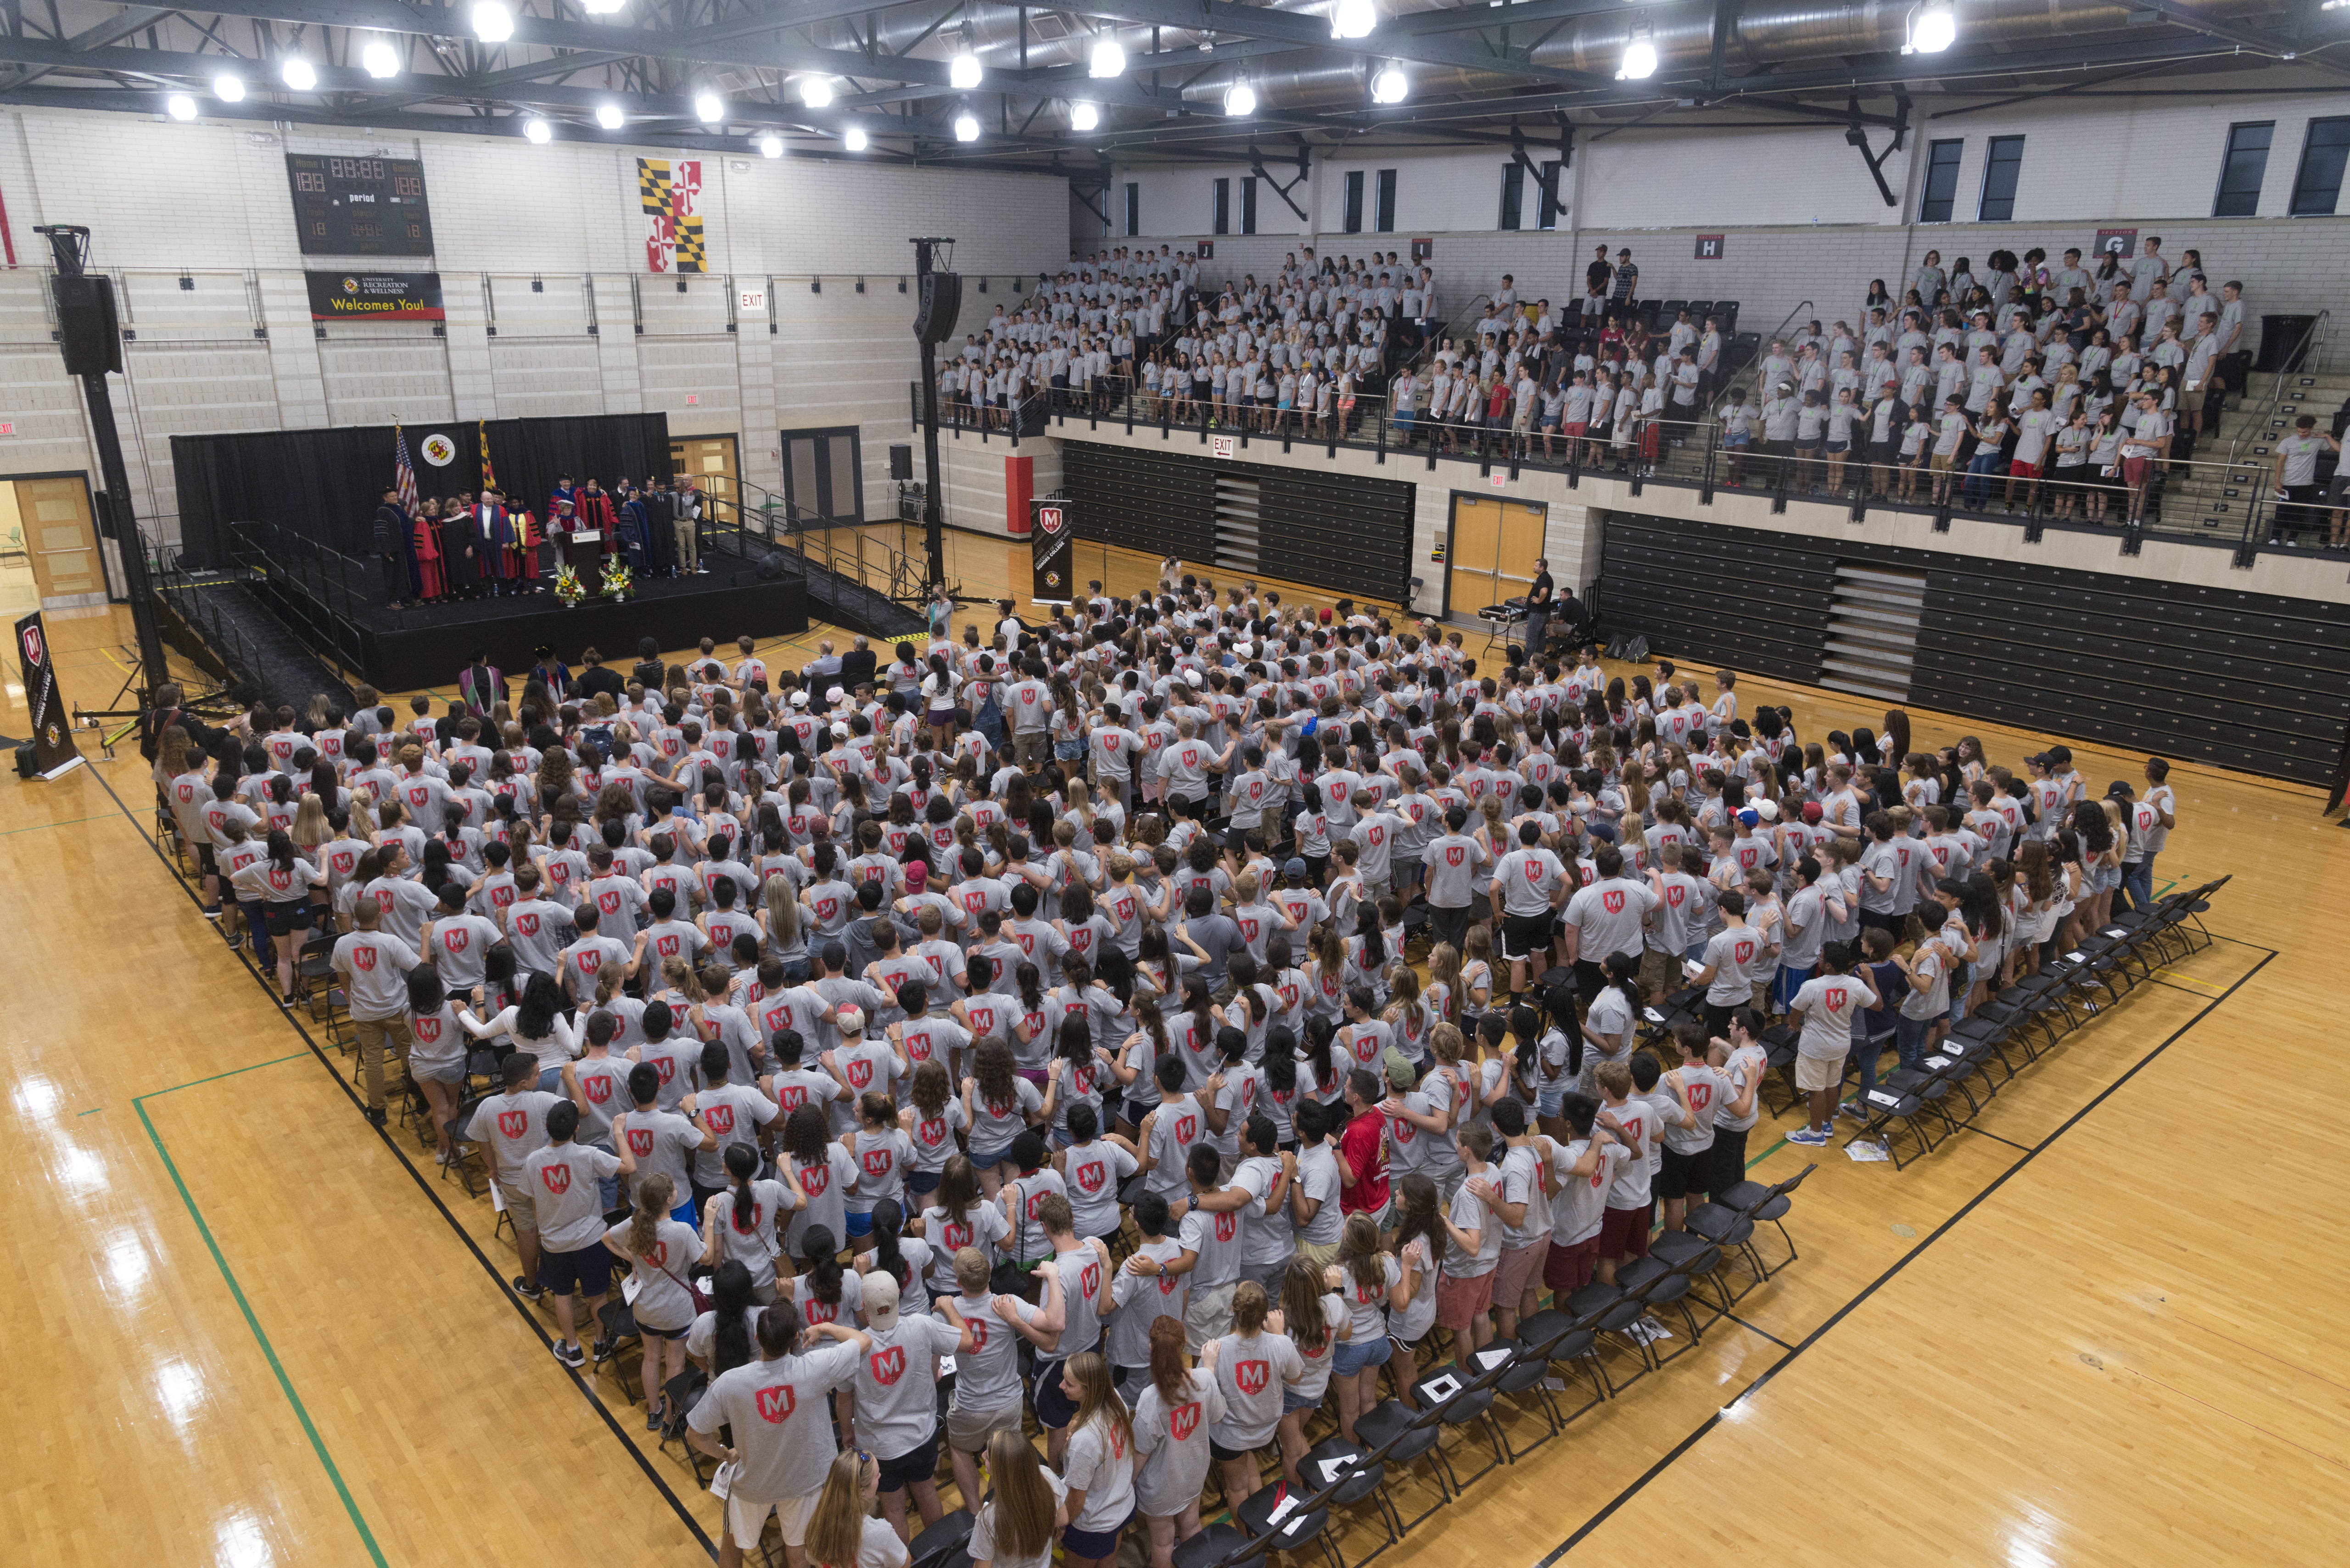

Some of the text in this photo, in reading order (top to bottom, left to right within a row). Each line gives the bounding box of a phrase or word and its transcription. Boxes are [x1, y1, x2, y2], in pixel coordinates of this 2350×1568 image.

[296, 159, 318, 168] Home
[349, 194, 375, 202] period
[1703, 241, 1715, 256] H
[2105, 236, 2123, 253] G
[1203, 246, 1208, 257] J
[331, 298, 424, 310] Welcomes You!
[743, 295, 762, 306] EXIT
[1215, 438, 1231, 451] EXIT
[1493, 475, 1504, 485] EXIT
[1045, 512, 1058, 525] M
[1034, 550, 1050, 568] UNIVERSITY
[1054, 530, 1071, 547] MARYLAND
[1036, 541, 1065, 570] HONORS COLLEGE
[27, 631, 39, 655] M
[979, 685, 986, 693] M
[1024, 691, 1032, 699] M
[1218, 707, 1225, 715] M
[799, 725, 808, 734] M
[1676, 720, 1682, 728] M
[328, 741, 337, 751] M
[667, 742, 676, 751] M
[1107, 737, 1116, 746] M
[1151, 735, 1159, 745] M
[278, 744, 289, 754] M
[717, 743, 725, 752] M
[514, 758, 524, 769] M
[1186, 752, 1194, 762] M
[588, 774, 599, 786] M
[181, 787, 190, 798] M
[1253, 784, 1260, 793] M
[1334, 785, 1343, 796] M
[1473, 782, 1481, 794] M
[1500, 783, 1508, 793] M
[414, 790, 425, 801] M
[914, 793, 924, 804] M
[980, 812, 990, 824] M
[723, 826, 732, 838] M
[938, 831, 949, 842] M
[1372, 829, 1381, 841] M
[895, 835, 905, 846] M
[451, 843, 463, 853] M
[1450, 849, 1460, 860] M
[336, 854, 350, 867] M
[1745, 851, 1753, 863] M
[553, 865, 565, 878] M
[870, 869, 881, 881] M
[1529, 864, 1539, 875] M
[274, 872, 287, 884] M
[496, 888, 510, 902] M
[970, 894, 982, 908] M
[1608, 893, 1621, 907] M
[1671, 888, 1681, 901] M
[603, 894, 616, 909] M
[821, 901, 834, 914] M
[1121, 900, 1133, 915] M
[1292, 905, 1303, 917] M
[521, 917, 536, 930] M
[1243, 922, 1255, 937] M
[450, 931, 464, 946] M
[715, 929, 727, 941] M
[1076, 932, 1087, 945] M
[662, 938, 676, 953] M
[1739, 944, 1749, 957] M
[359, 950, 373, 964] M
[582, 953, 598, 968] M
[1830, 992, 1842, 1005] M
[772, 1010, 789, 1027] M
[974, 1012, 989, 1028] M
[1027, 1015, 1041, 1032] M
[420, 1021, 436, 1035] M
[912, 1037, 928, 1054] M
[1361, 1039, 1374, 1055] M
[853, 1063, 868, 1081] M
[590, 1079, 607, 1096] M
[785, 1089, 804, 1107] M
[1692, 1088, 1706, 1103] M
[504, 1114, 522, 1131] M
[711, 1109, 730, 1127] M
[926, 1121, 942, 1139] M
[1180, 1119, 1192, 1138] M
[1399, 1121, 1413, 1136] M
[632, 1133, 649, 1149] M
[869, 1153, 887, 1170] M
[548, 1168, 566, 1186] M
[807, 1168, 824, 1189] M
[1083, 1165, 1101, 1184] M
[1219, 1212, 1231, 1234] M
[951, 1224, 970, 1244] M
[878, 1351, 900, 1378] M
[1242, 1365, 1263, 1385] M
[764, 1390, 789, 1415] M
[1177, 1407, 1194, 1432] M
